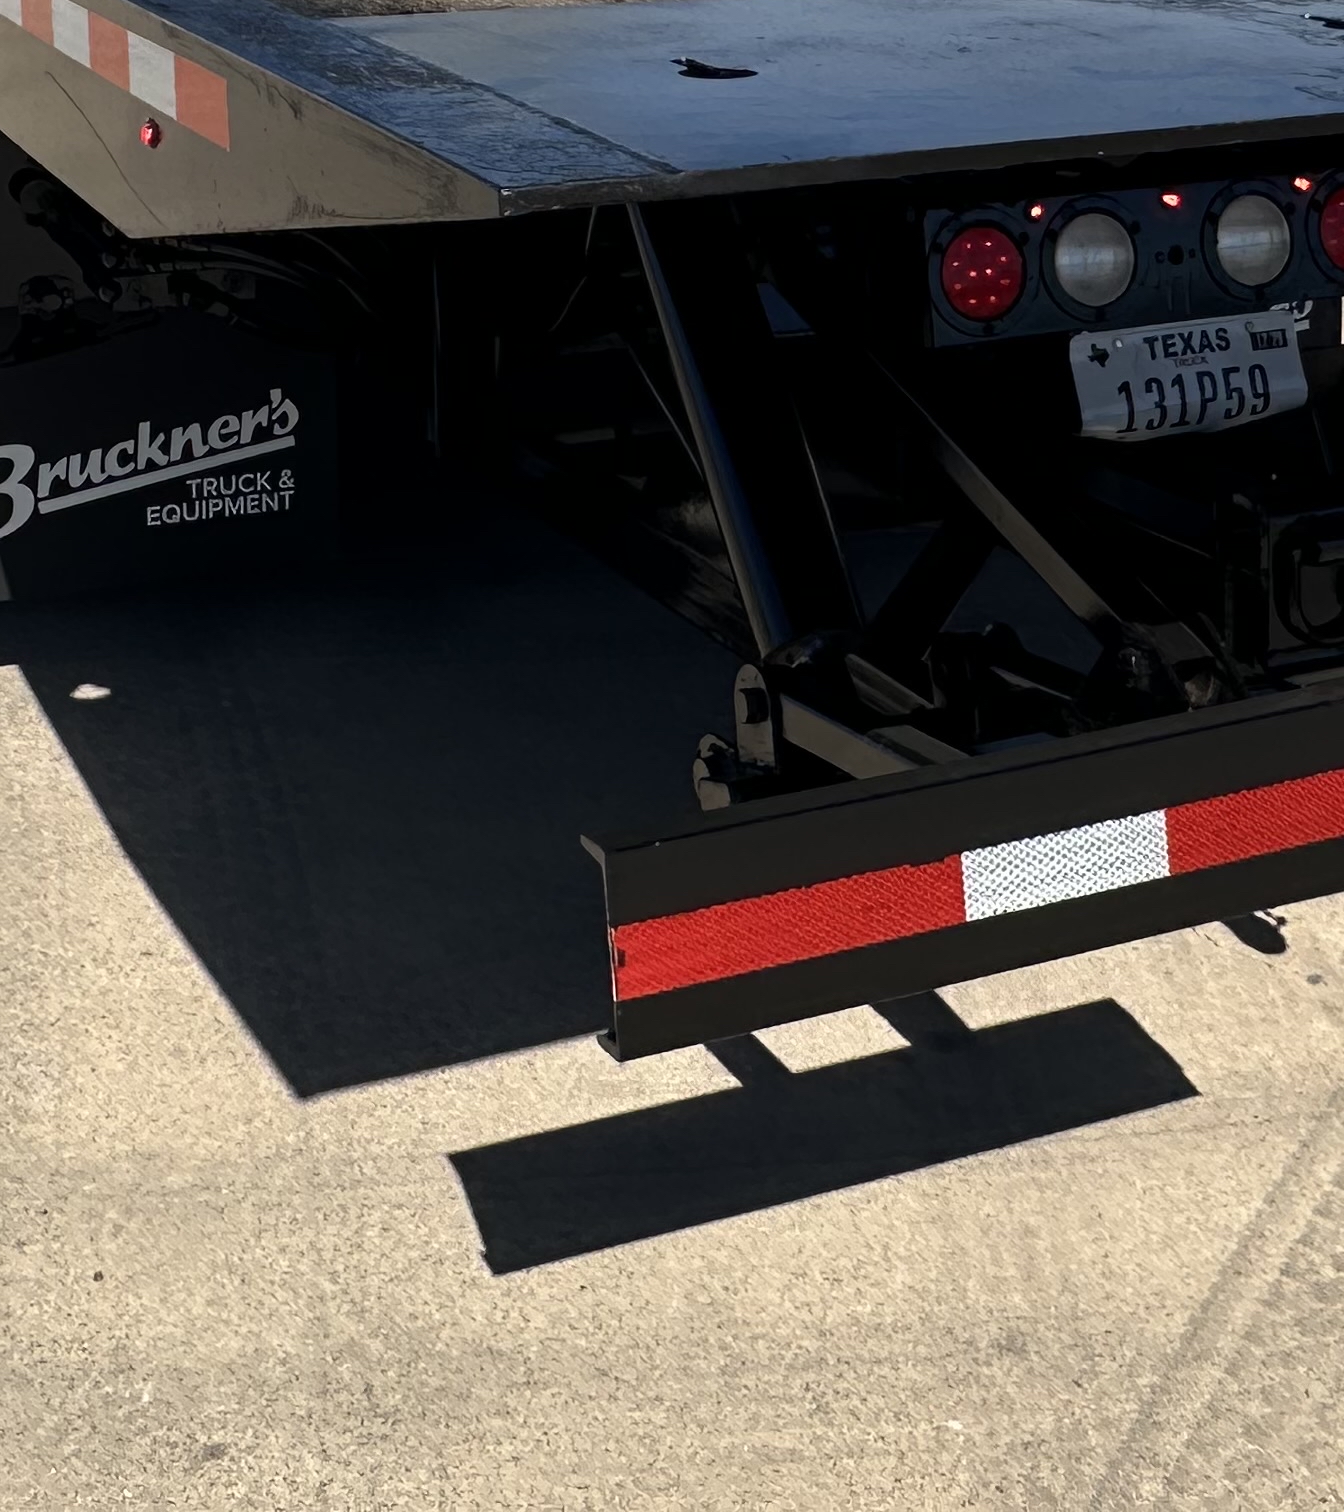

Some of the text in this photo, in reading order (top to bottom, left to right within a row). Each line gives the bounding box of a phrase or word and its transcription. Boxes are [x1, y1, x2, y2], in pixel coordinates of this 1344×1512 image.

[1143, 327, 1231, 360] TEXAS
[1116, 363, 1272, 434] 131P59
[186, 469, 296, 499] TRUCK &
[146, 490, 295, 526] EQUIPMENT
